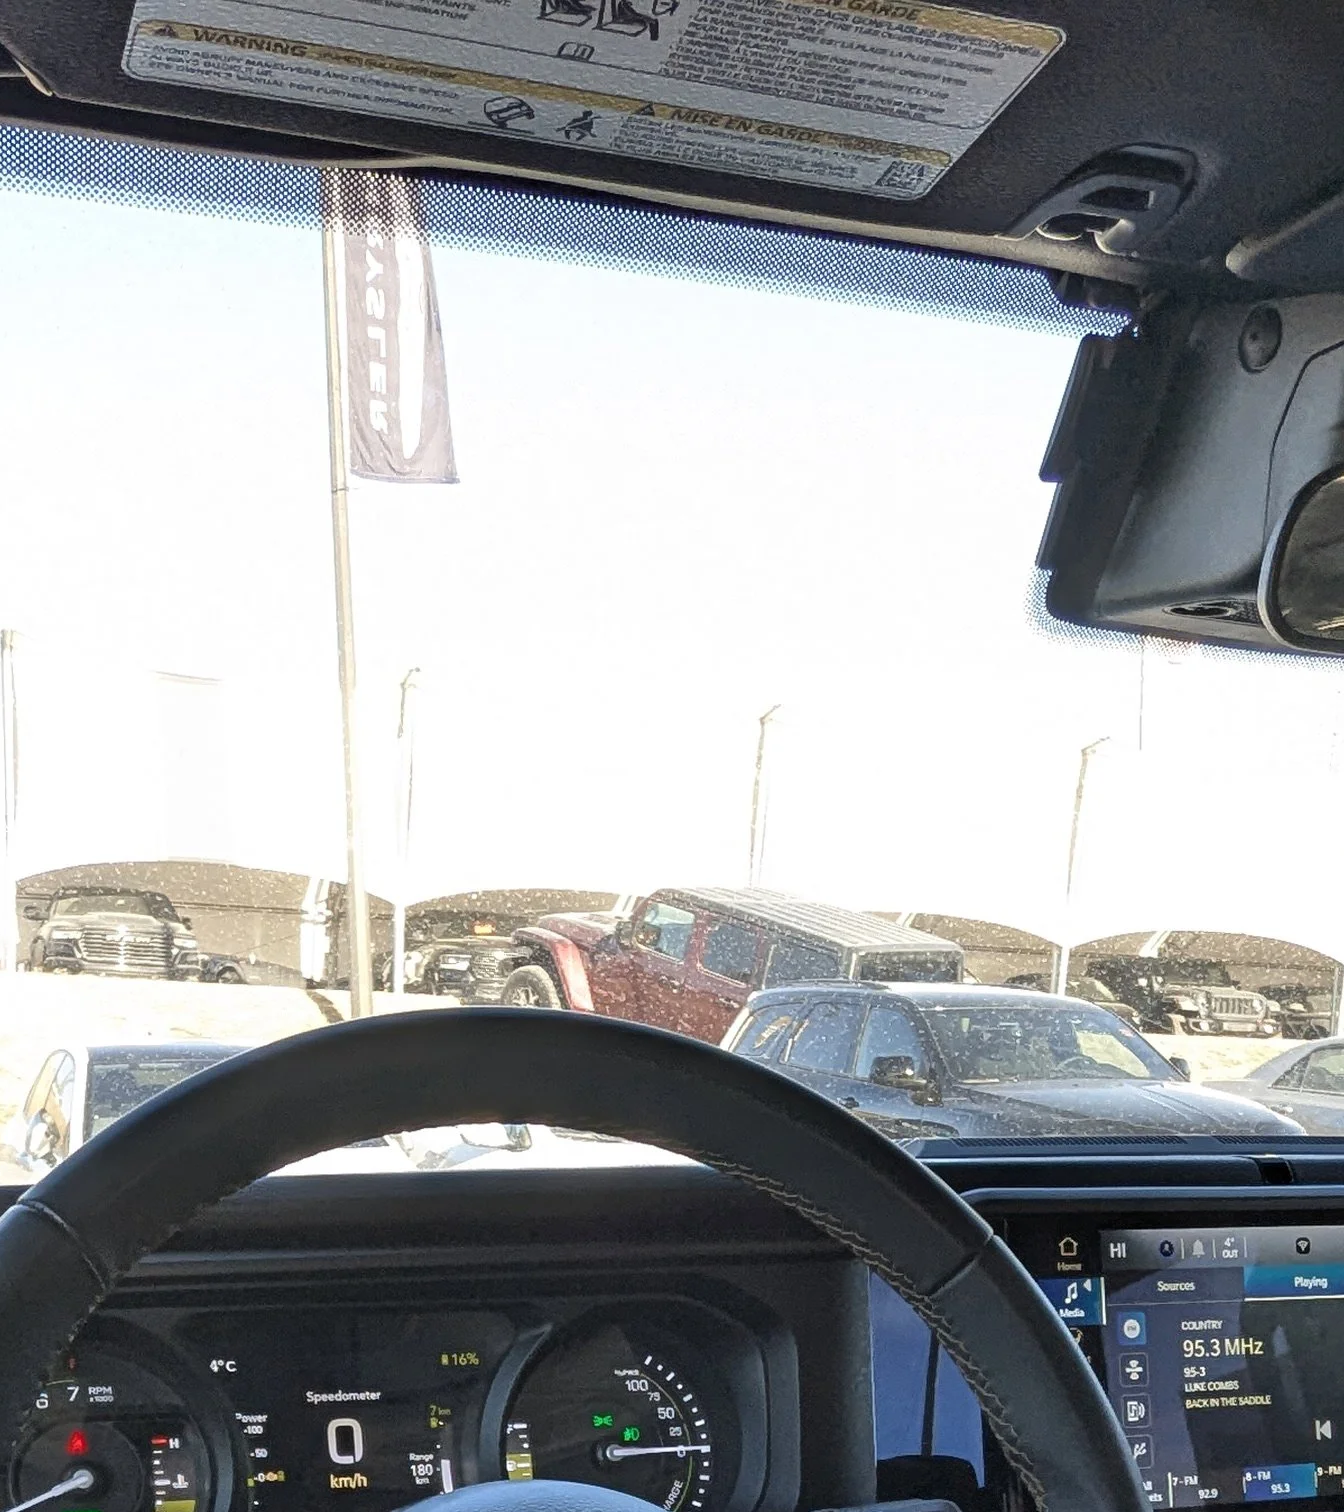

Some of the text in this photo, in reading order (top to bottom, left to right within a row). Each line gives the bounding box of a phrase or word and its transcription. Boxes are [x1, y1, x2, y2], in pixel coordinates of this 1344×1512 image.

[193, 28, 308, 58] WARNING
[669, 108, 824, 145] MISE EN GARDE
[1108, 1242, 1127, 1259] HI
[1221, 1249, 1239, 1259] OUT
[1056, 1261, 1083, 1272] Home
[1156, 1280, 1196, 1292] Sources
[1294, 1275, 1328, 1290] Playing
[1058, 1308, 1086, 1319] Media
[1181, 1319, 1224, 1331] COUNTRY
[1182, 1338, 1264, 1358] 95.3 MHz
[451, 1352, 480, 1366] 16%
[1183, 1366, 1207, 1378] 95-3
[624, 1379, 649, 1392] 100
[1184, 1379, 1240, 1393] LUKE COMBS
[35, 1385, 113, 1410] 6 7 RPM
[306, 1390, 381, 1405] Speedometer
[647, 1391, 661, 1402] 75
[1185, 1398, 1210, 1410] BACK
[1220, 1396, 1237, 1407] THE
[1238, 1394, 1272, 1407] SADDLE
[235, 1412, 268, 1424] Power
[657, 1406, 676, 1420] 50
[169, 1437, 180, 1449] H
[326, 1417, 364, 1465] 0
[409, 1451, 434, 1462] Range
[410, 1463, 434, 1477] 180
[330, 1471, 369, 1490] km/h
[664, 1479, 685, 1511] ARGE
[1198, 1488, 1218, 1499] 92.9
[1271, 1483, 1291, 1494] 95.3
